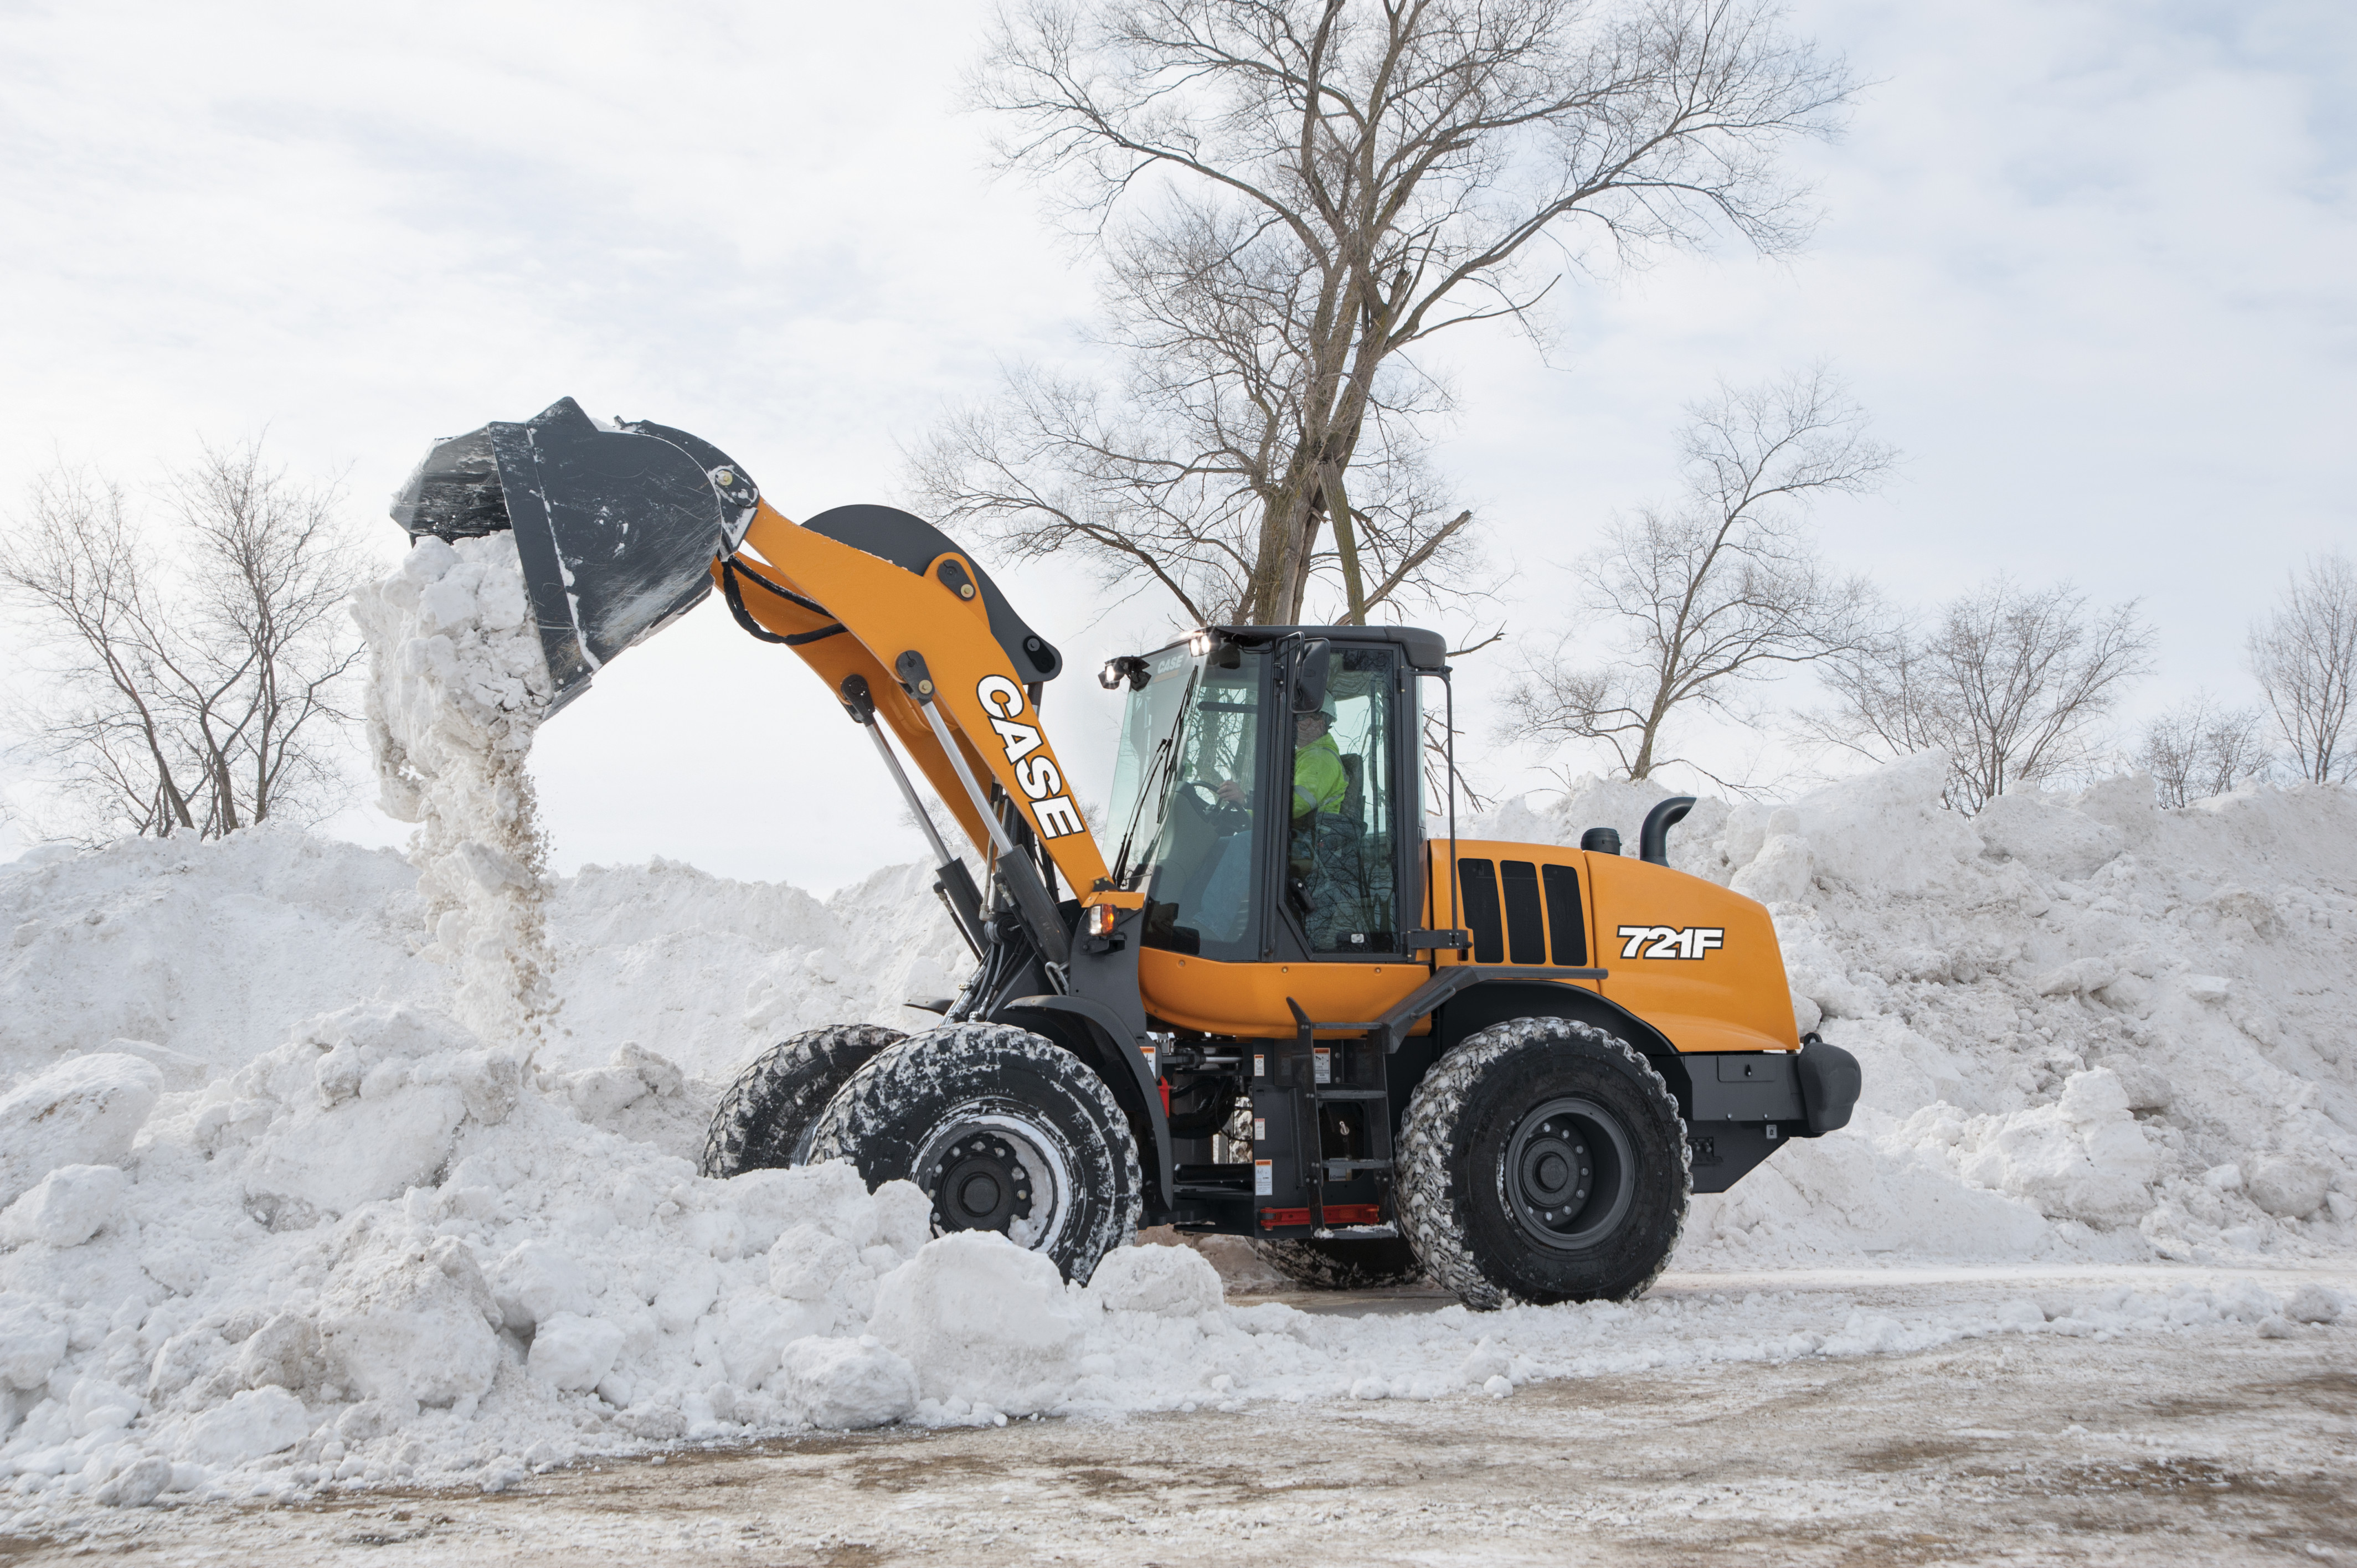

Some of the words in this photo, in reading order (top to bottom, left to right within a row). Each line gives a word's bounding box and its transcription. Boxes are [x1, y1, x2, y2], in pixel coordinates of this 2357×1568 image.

[1157, 654, 1184, 674] CASE
[976, 674, 1085, 840] CASE
[1617, 925, 1725, 960] 721F
